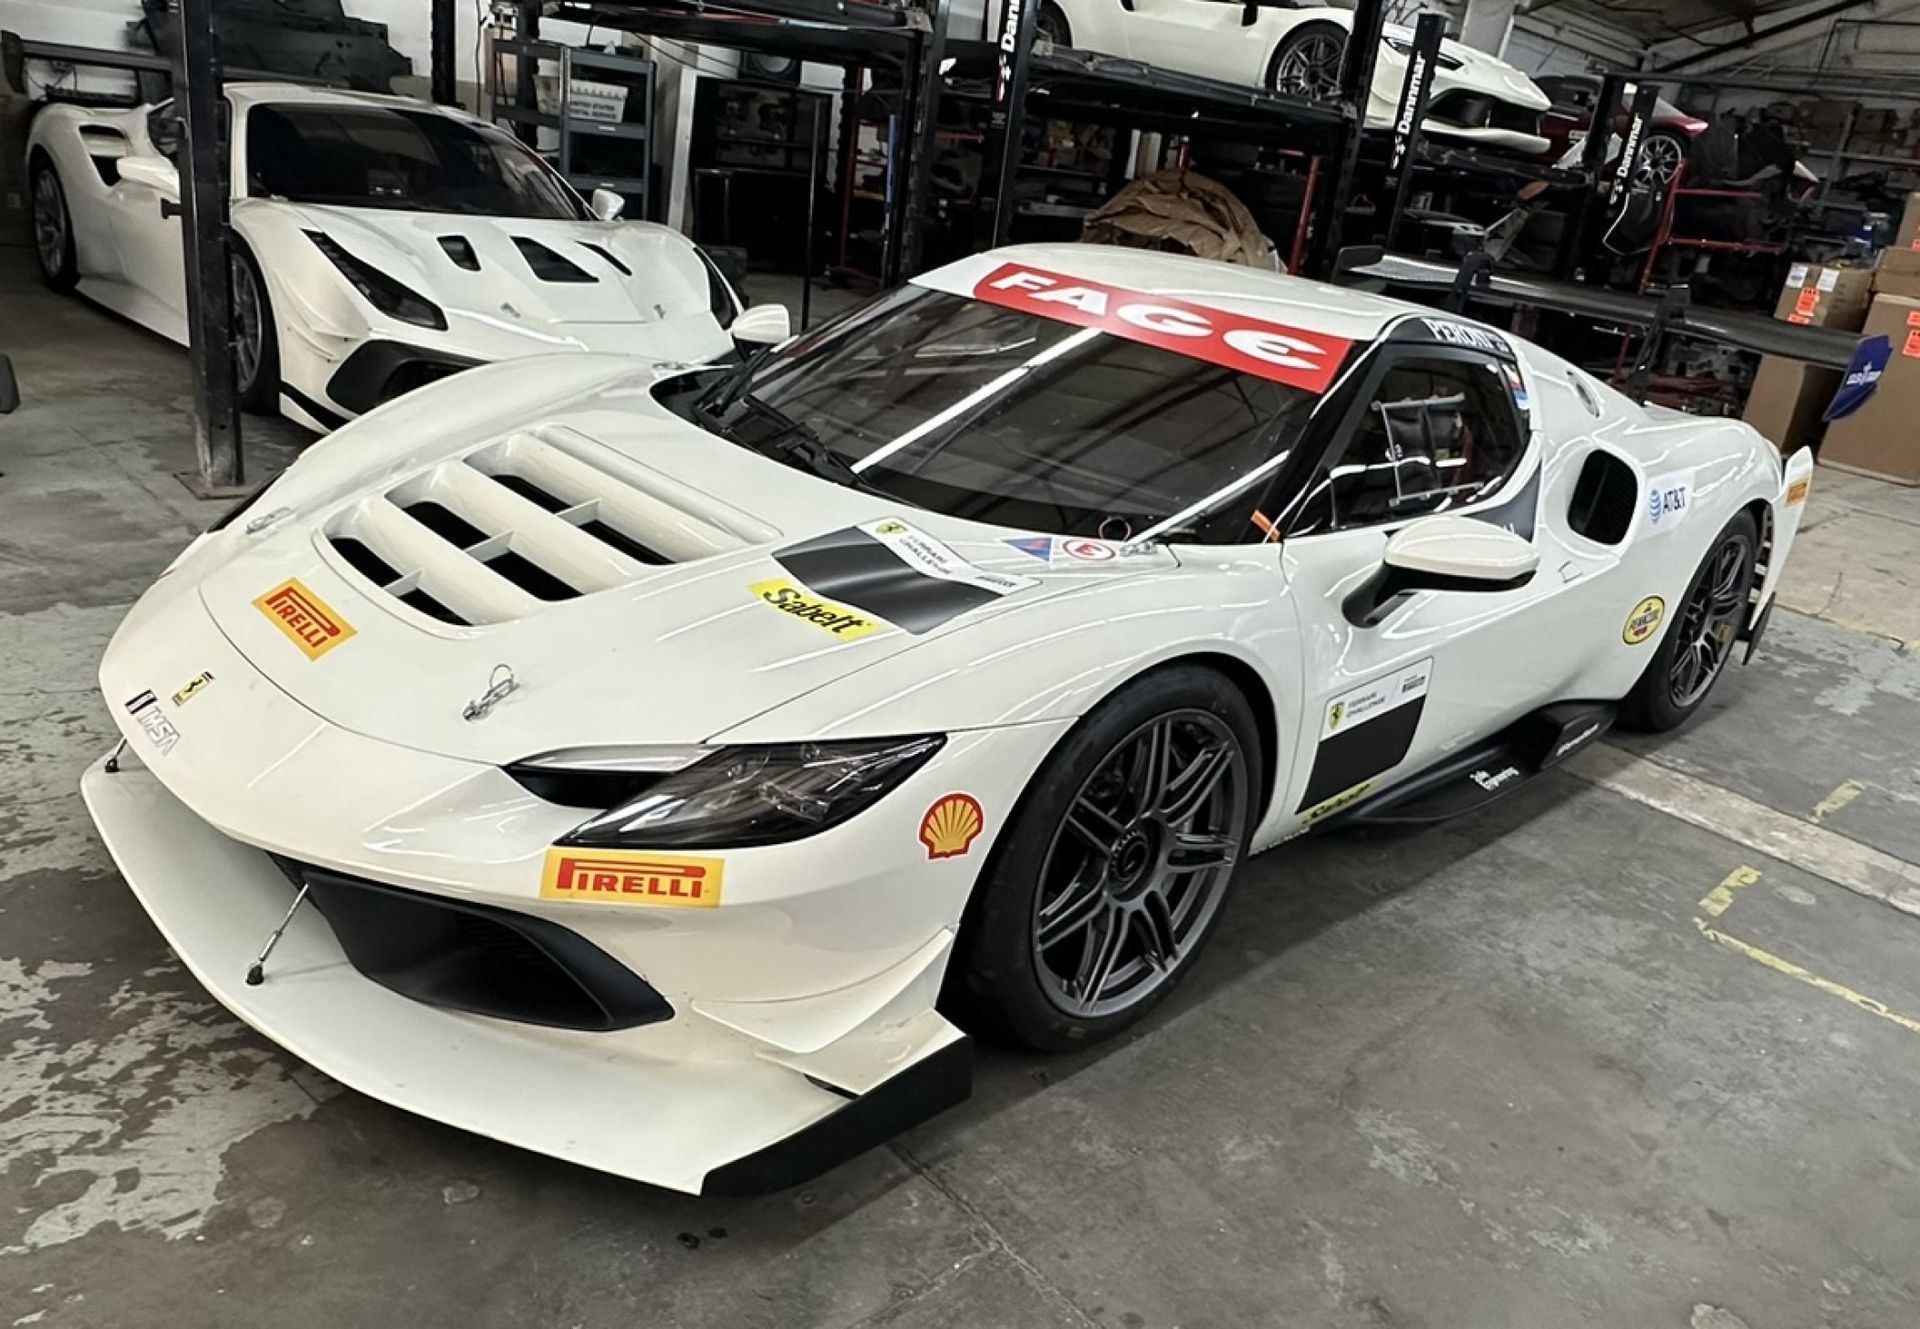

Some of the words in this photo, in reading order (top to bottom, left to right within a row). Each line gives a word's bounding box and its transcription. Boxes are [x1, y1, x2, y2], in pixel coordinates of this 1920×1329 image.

[1397, 50, 1426, 135] Dannmar
[1616, 112, 1643, 178] Dannmar
[989, 271, 1327, 371] FAGE
[1662, 487, 1686, 515] AT&T
[265, 586, 341, 648] PIRELLI
[763, 588, 864, 633] Sabelt
[556, 857, 706, 898] PIRELLI
